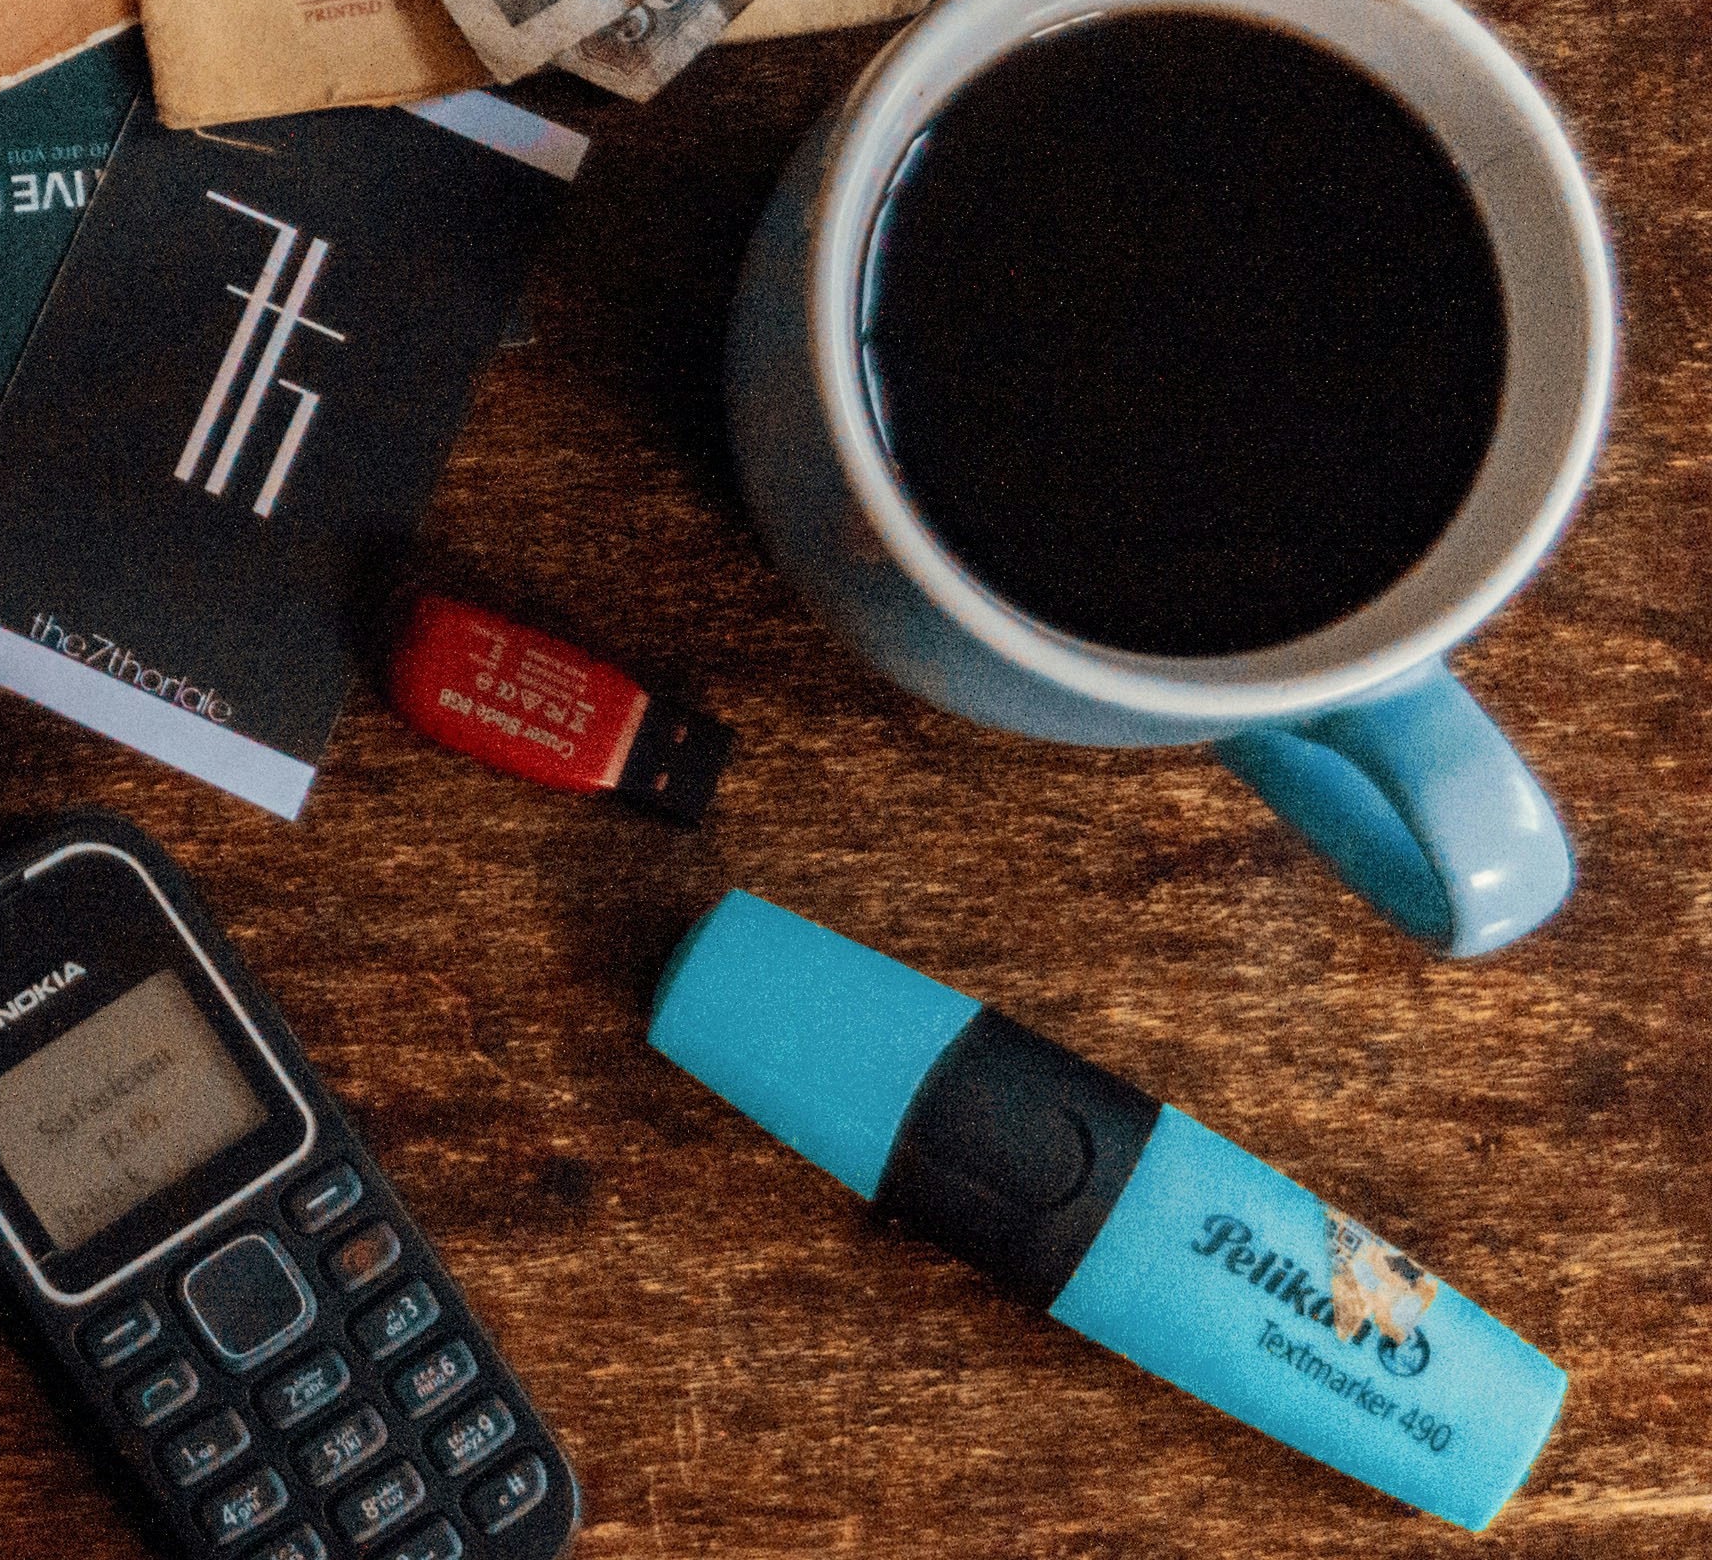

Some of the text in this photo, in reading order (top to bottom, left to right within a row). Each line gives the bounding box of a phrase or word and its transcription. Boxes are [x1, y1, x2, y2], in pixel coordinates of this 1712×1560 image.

[304, 0, 384, 25] PRINTED
[12, 166, 107, 215] IVE
[404, 1297, 420, 1318] 3
[440, 1357, 457, 1379] 6
[282, 1385, 300, 1407] 2
[1257, 1318, 1452, 1453] Textmarker 490
[477, 1413, 496, 1437] 9
[323, 1441, 342, 1469] 5
[223, 1504, 238, 1524] 4
[361, 1495, 379, 1519] 8
